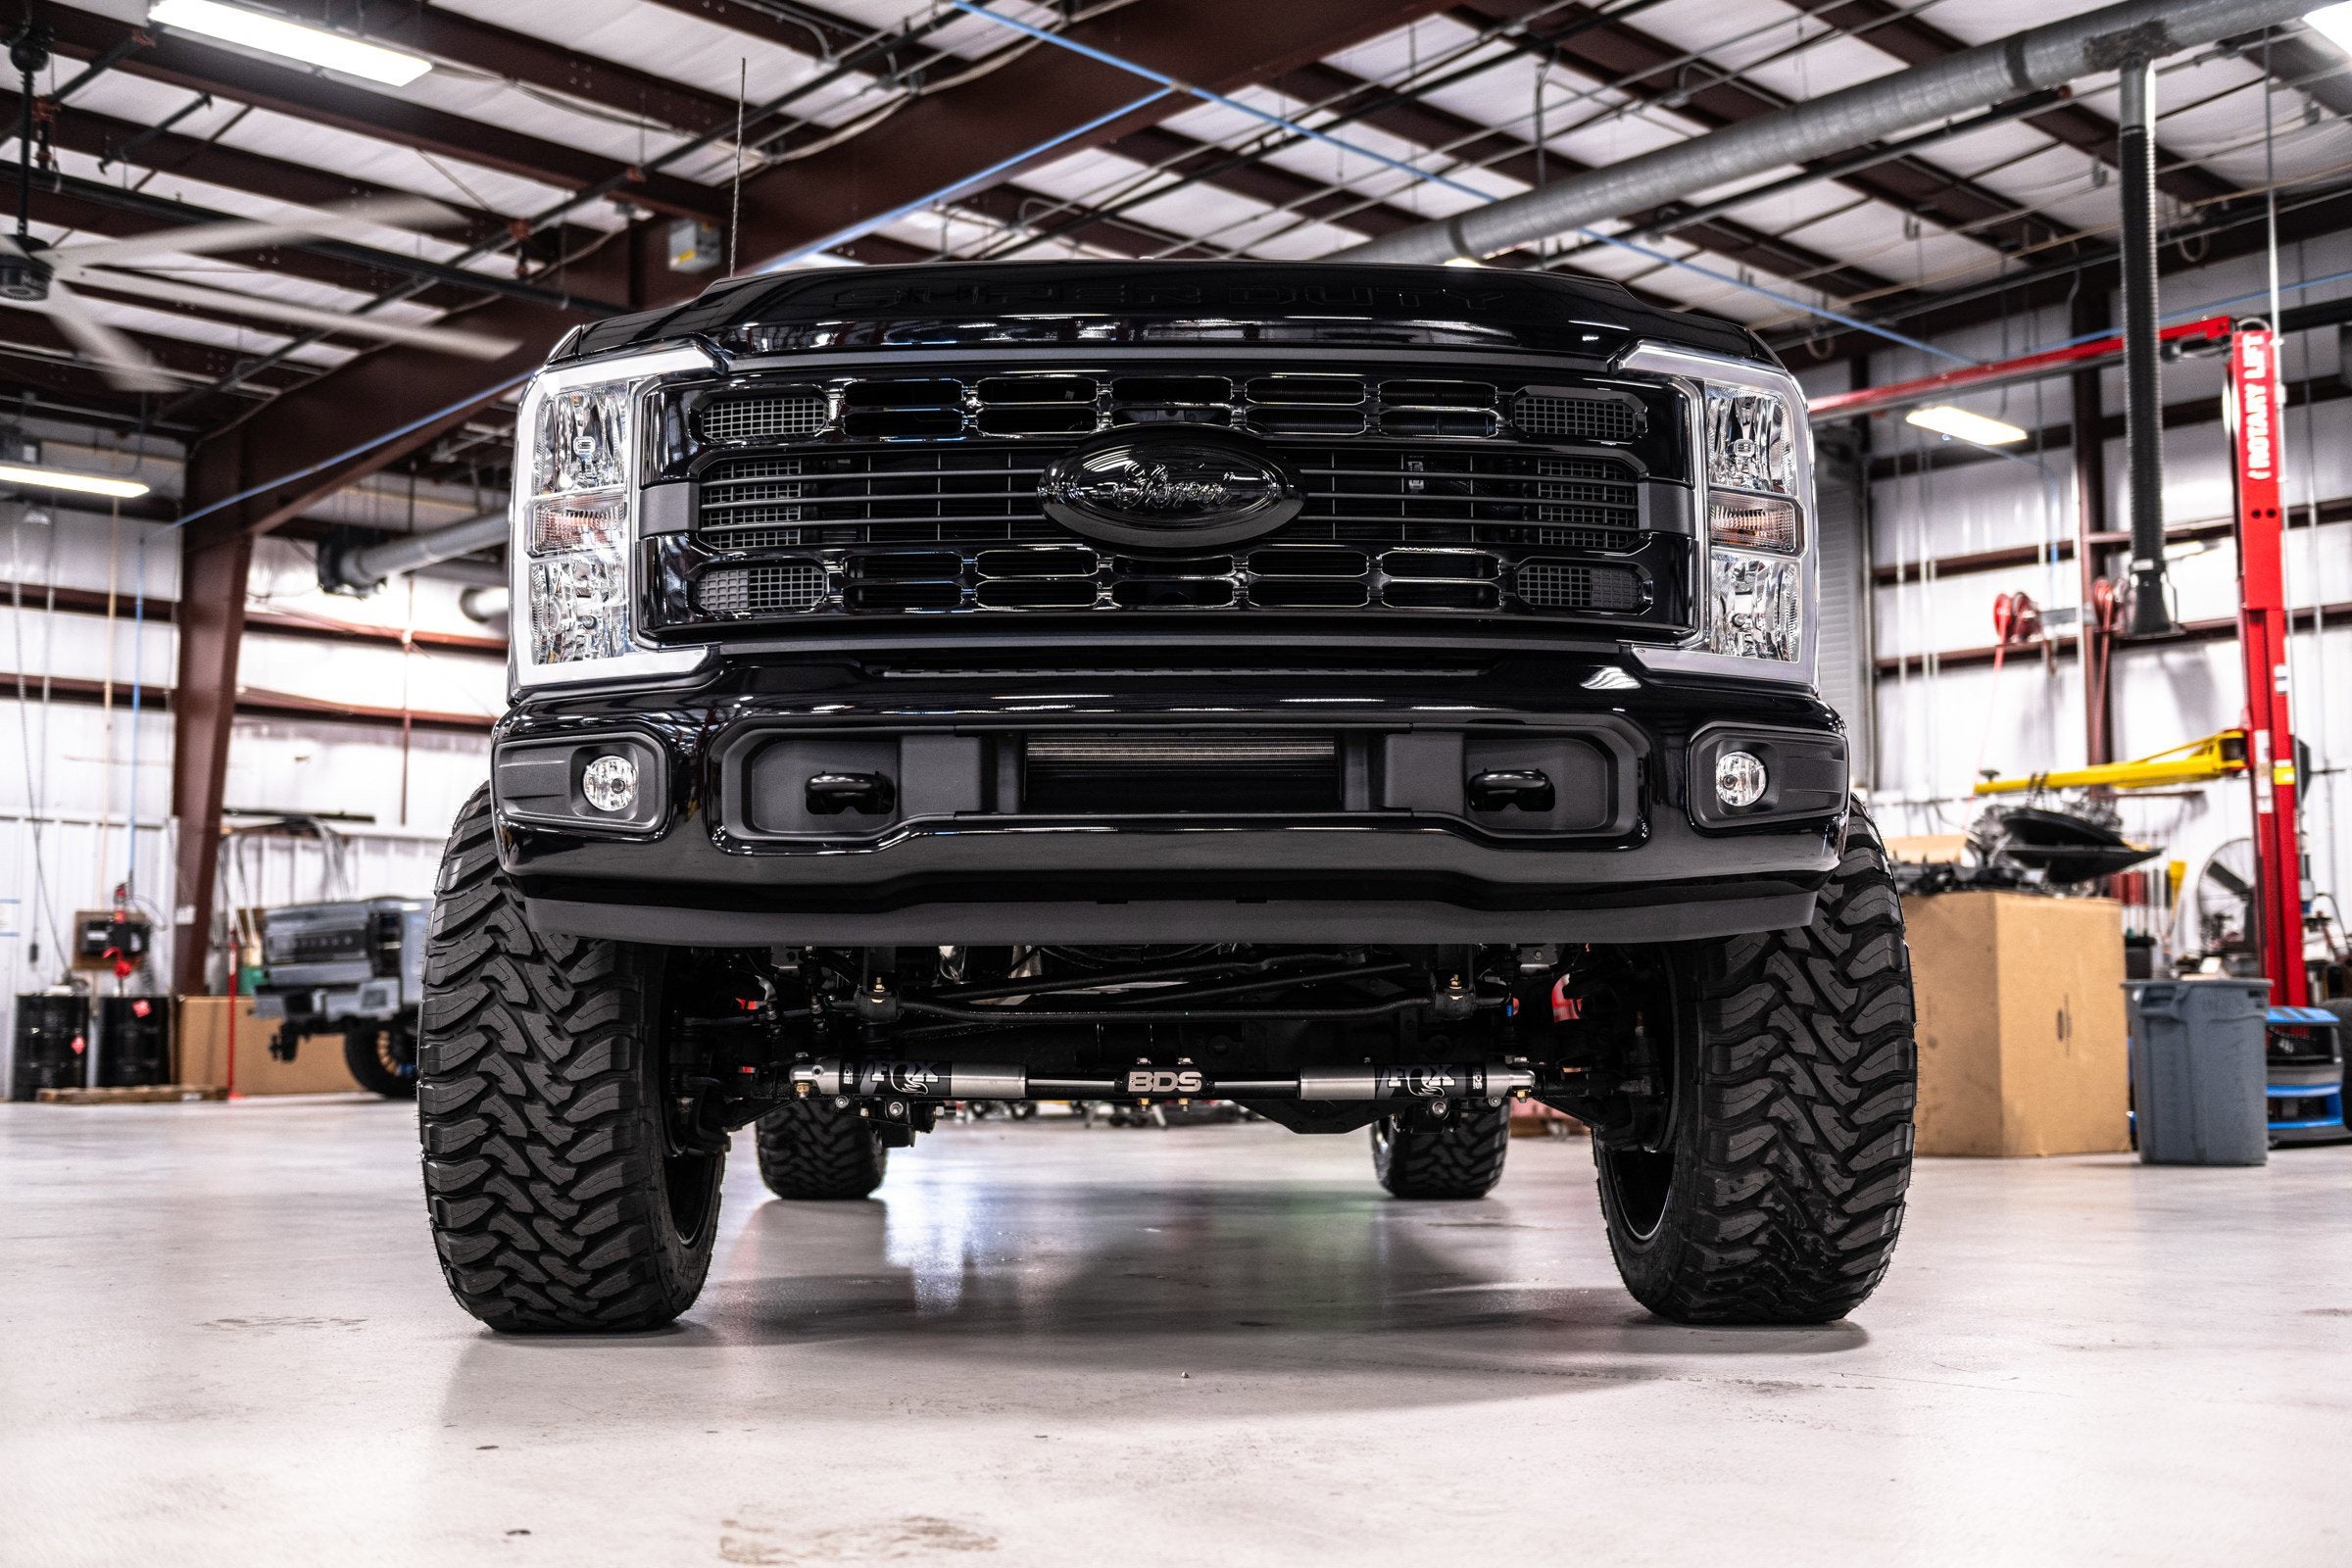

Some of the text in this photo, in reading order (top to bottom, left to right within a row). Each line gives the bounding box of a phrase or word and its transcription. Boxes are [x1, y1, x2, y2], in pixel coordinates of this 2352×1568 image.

[1228, 284, 1504, 311] DUTY
[871, 1062, 939, 1095] FOX
[1128, 1071, 1202, 1092] BDS
[1388, 1065, 1455, 1097] FOX
